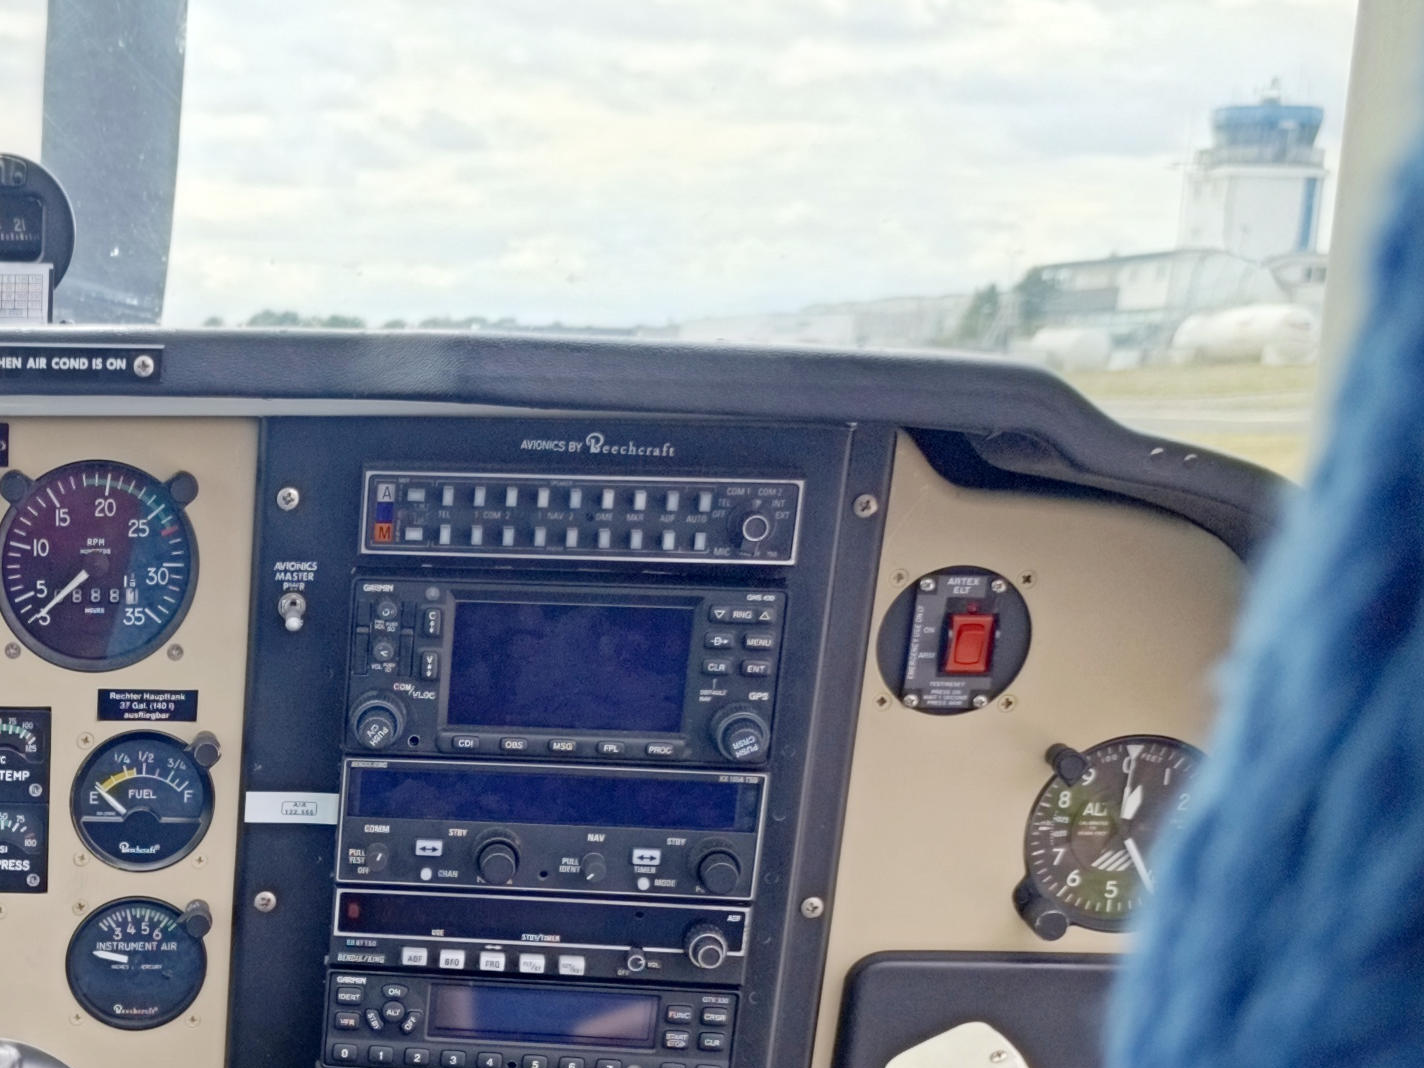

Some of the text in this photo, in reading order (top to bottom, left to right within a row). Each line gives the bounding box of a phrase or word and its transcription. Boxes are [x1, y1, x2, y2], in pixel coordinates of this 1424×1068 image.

[26, 357, 47, 370] AIR
[51, 357, 89, 371] COND
[92, 358, 103, 371] IS
[106, 358, 126, 371] ON
[520, 432, 676, 457] AVIONICS BY Beechcraft
[382, 486, 393, 500] A
[94, 498, 117, 517] 20
[55, 508, 71, 527] 15
[128, 519, 150, 537] 25
[378, 525, 392, 540] M
[33, 539, 49, 557] 10
[273, 561, 318, 571] AVIONICS
[145, 567, 169, 585] 30
[275, 571, 315, 582] MASTER
[947, 576, 981, 587] ARTEX
[36, 579, 48, 598] 5
[282, 582, 306, 592] PWR
[952, 585, 972, 595] ELT
[123, 607, 146, 625] 35
[923, 626, 936, 635] ON
[745, 637, 772, 648] MENU
[707, 663, 726, 673] CLR
[747, 664, 766, 674] ENT
[109, 691, 186, 703] Rechter Haupttank
[748, 691, 769, 701] GPS
[123, 709, 171, 721] ausfliegbar
[504, 740, 524, 750] OBS
[552, 741, 573, 752] MSG
[603, 743, 620, 753] FPL
[647, 744, 674, 755] PROC
[128, 788, 157, 799] FUEL
[1057, 790, 1071, 809] 8
[364, 824, 391, 834] COMM
[448, 828, 468, 838] STBY
[587, 833, 606, 843] NAV
[666, 837, 687, 847] STBY
[1052, 848, 1065, 866] 7
[633, 865, 657, 875] TIMER
[1066, 869, 1080, 887] 6
[1104, 880, 1118, 899] 5
[96, 941, 178, 951] INSTRUMENT AIR
[667, 1010, 692, 1020] FUNC
